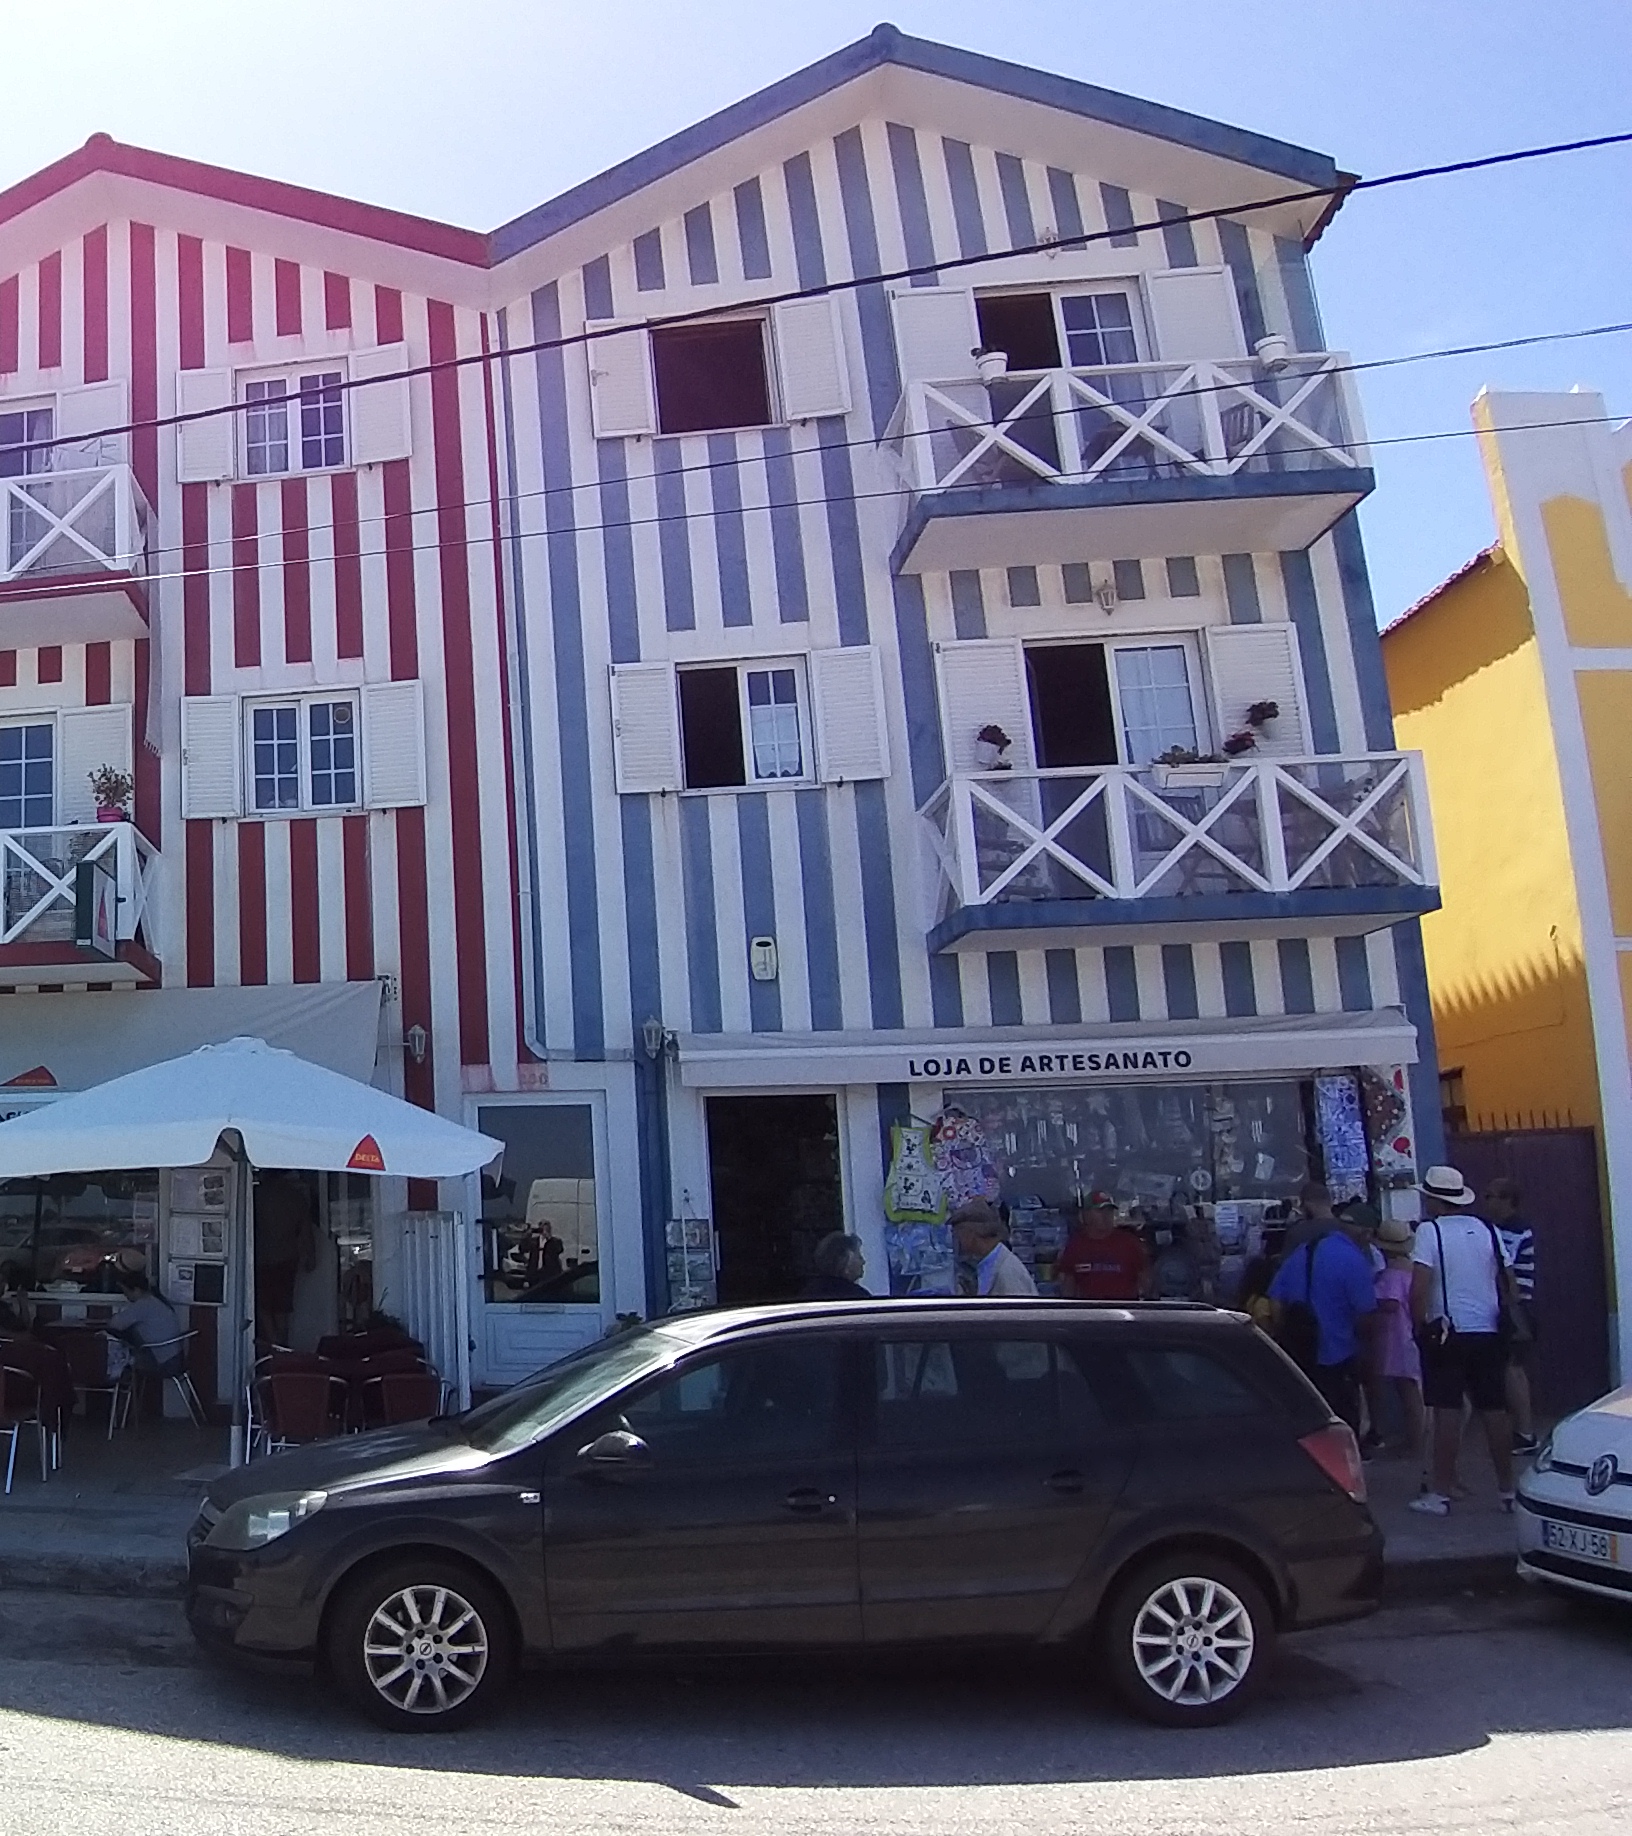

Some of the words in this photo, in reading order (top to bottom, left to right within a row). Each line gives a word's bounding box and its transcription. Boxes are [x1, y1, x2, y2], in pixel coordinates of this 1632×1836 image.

[909, 1057, 972, 1077] LOJA
[979, 1056, 1013, 1075] DE
[1020, 1050, 1193, 1073] ARTESANATO
